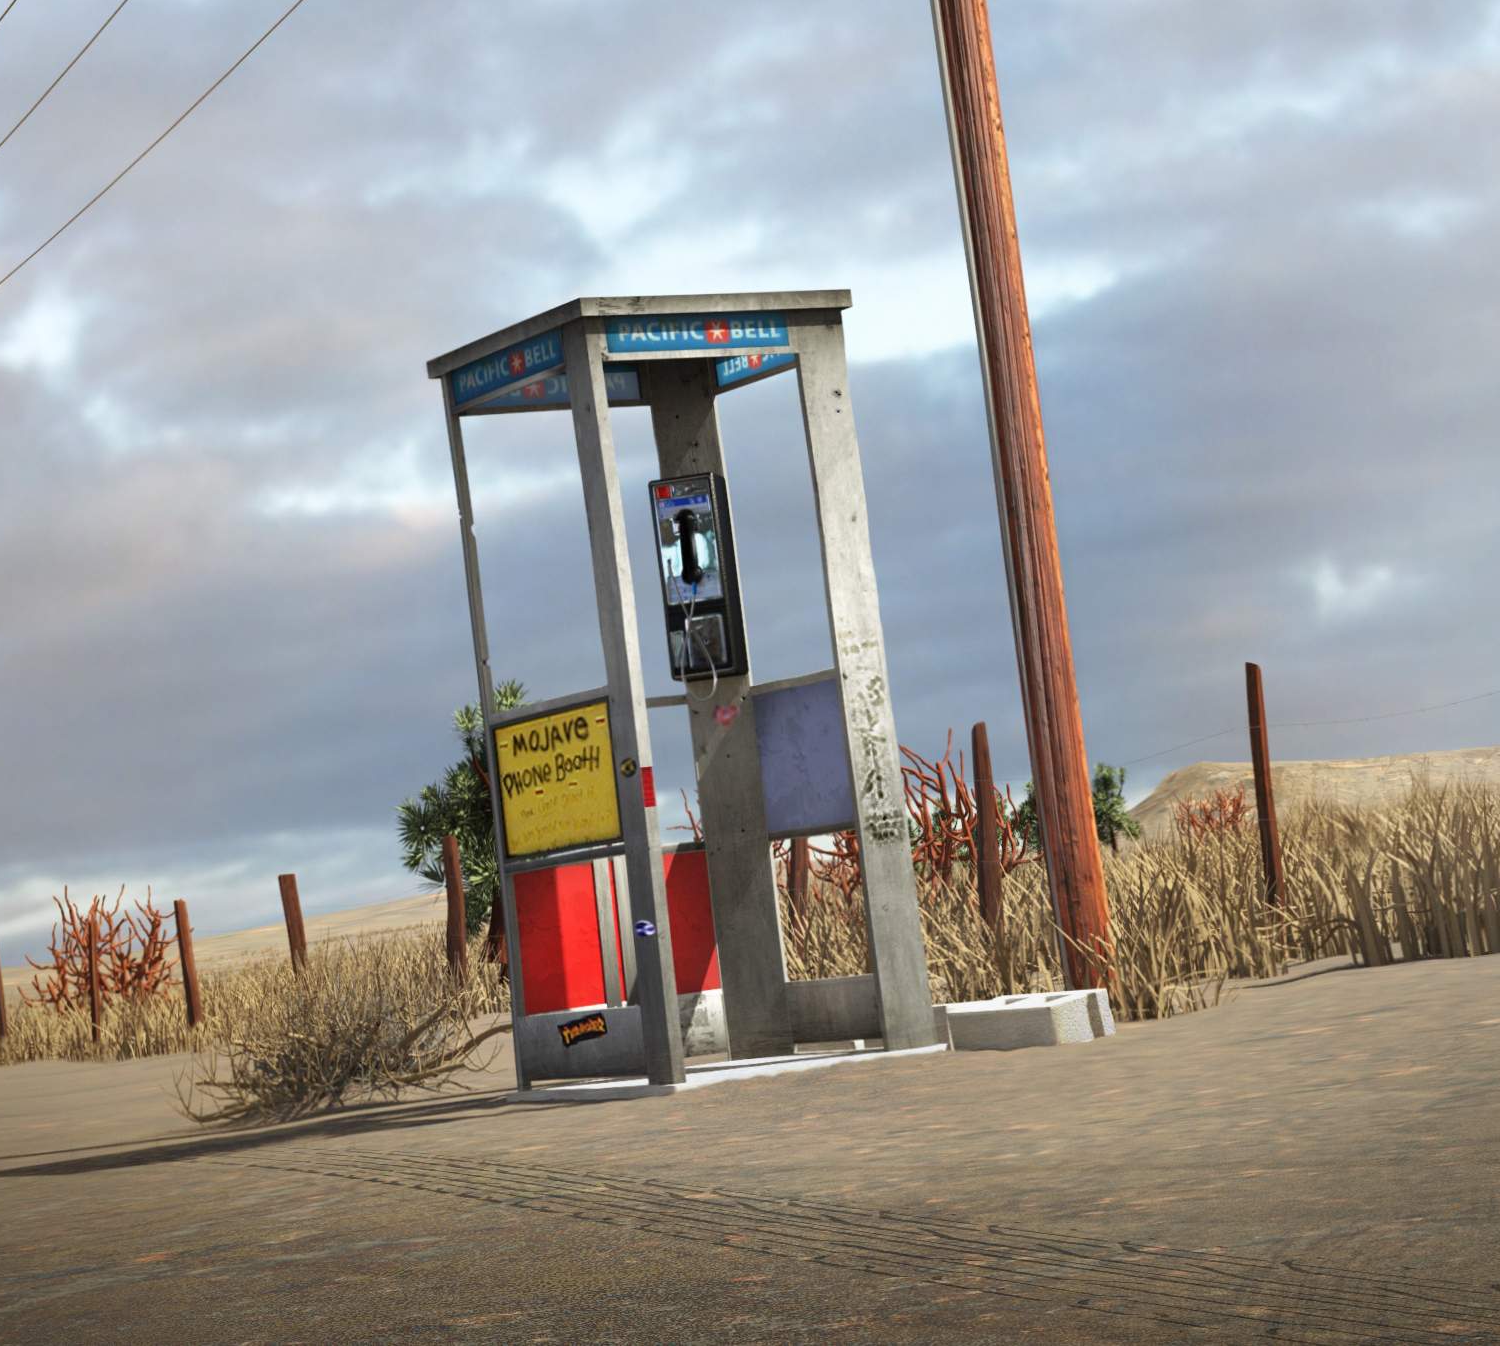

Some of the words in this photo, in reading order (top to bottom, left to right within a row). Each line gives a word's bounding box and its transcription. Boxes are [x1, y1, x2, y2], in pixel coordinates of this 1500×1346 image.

[618, 321, 705, 342] PACIFIC
[730, 320, 781, 340] BELL
[459, 357, 509, 392] PACIFIC
[524, 340, 557, 366] BELL
